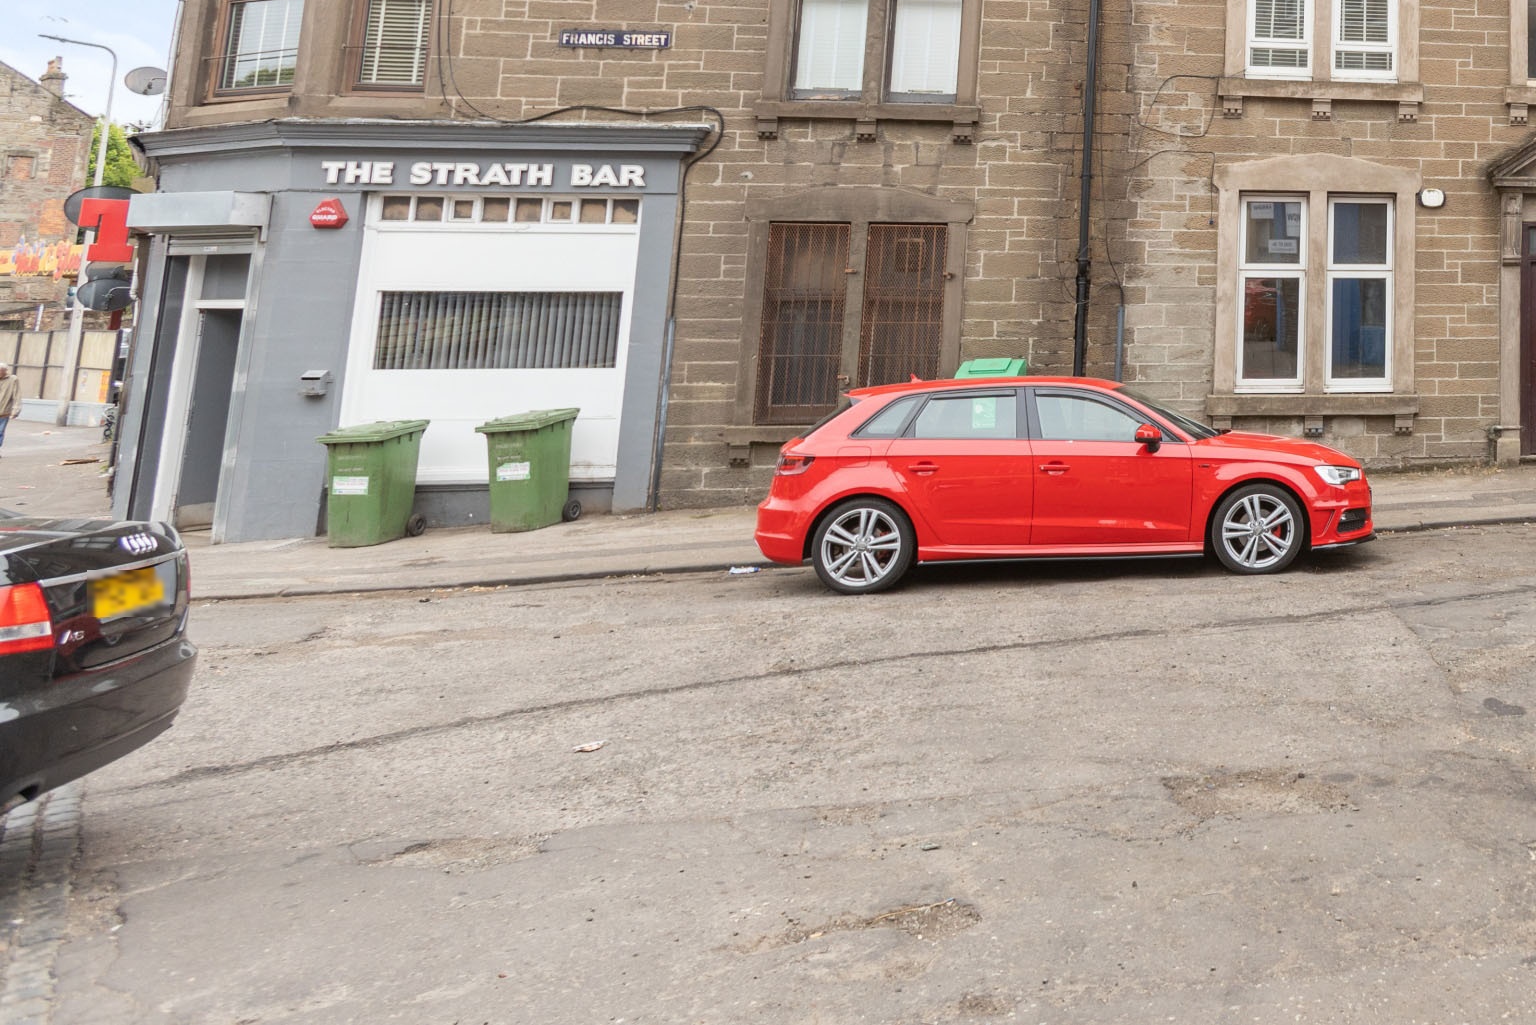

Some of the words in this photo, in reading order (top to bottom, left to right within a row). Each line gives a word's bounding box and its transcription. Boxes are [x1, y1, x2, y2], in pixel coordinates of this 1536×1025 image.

[562, 33, 615, 45] FRANCIS
[623, 34, 667, 46] STREET
[321, 161, 394, 184] THE
[410, 162, 554, 187] STRATH
[570, 164, 646, 187] BAR
